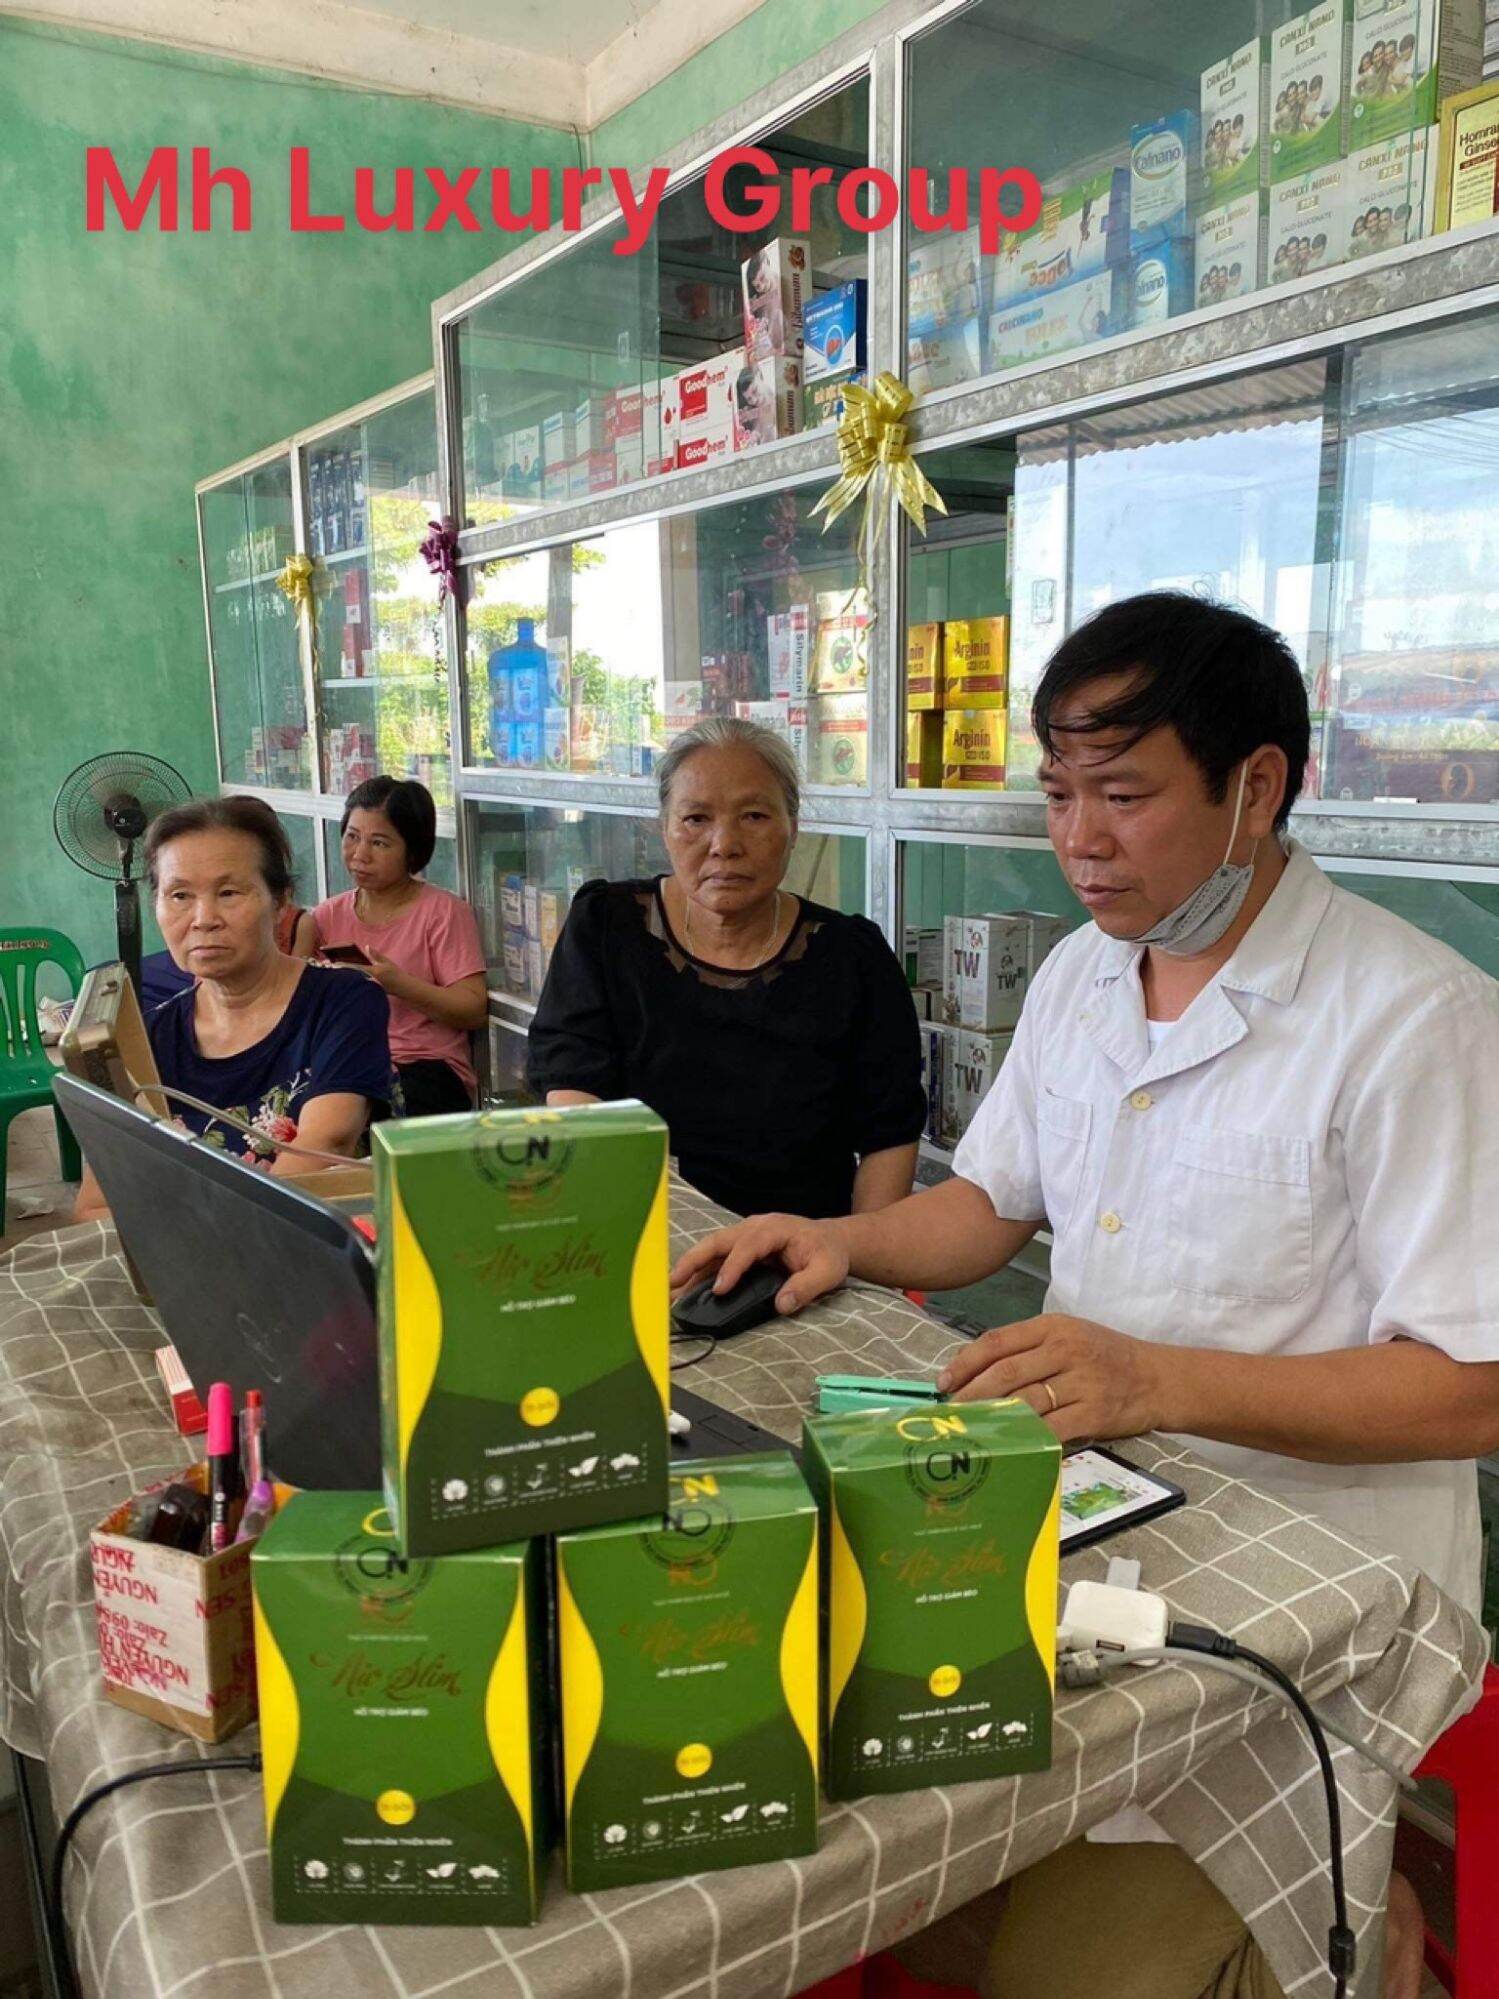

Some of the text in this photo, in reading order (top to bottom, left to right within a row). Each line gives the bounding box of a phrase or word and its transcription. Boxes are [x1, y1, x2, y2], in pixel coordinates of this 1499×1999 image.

[953, 728, 990, 750] Arginin
[954, 949, 980, 978] TW
[954, 1063, 983, 1094] TW
[927, 1452, 970, 1481] CN
